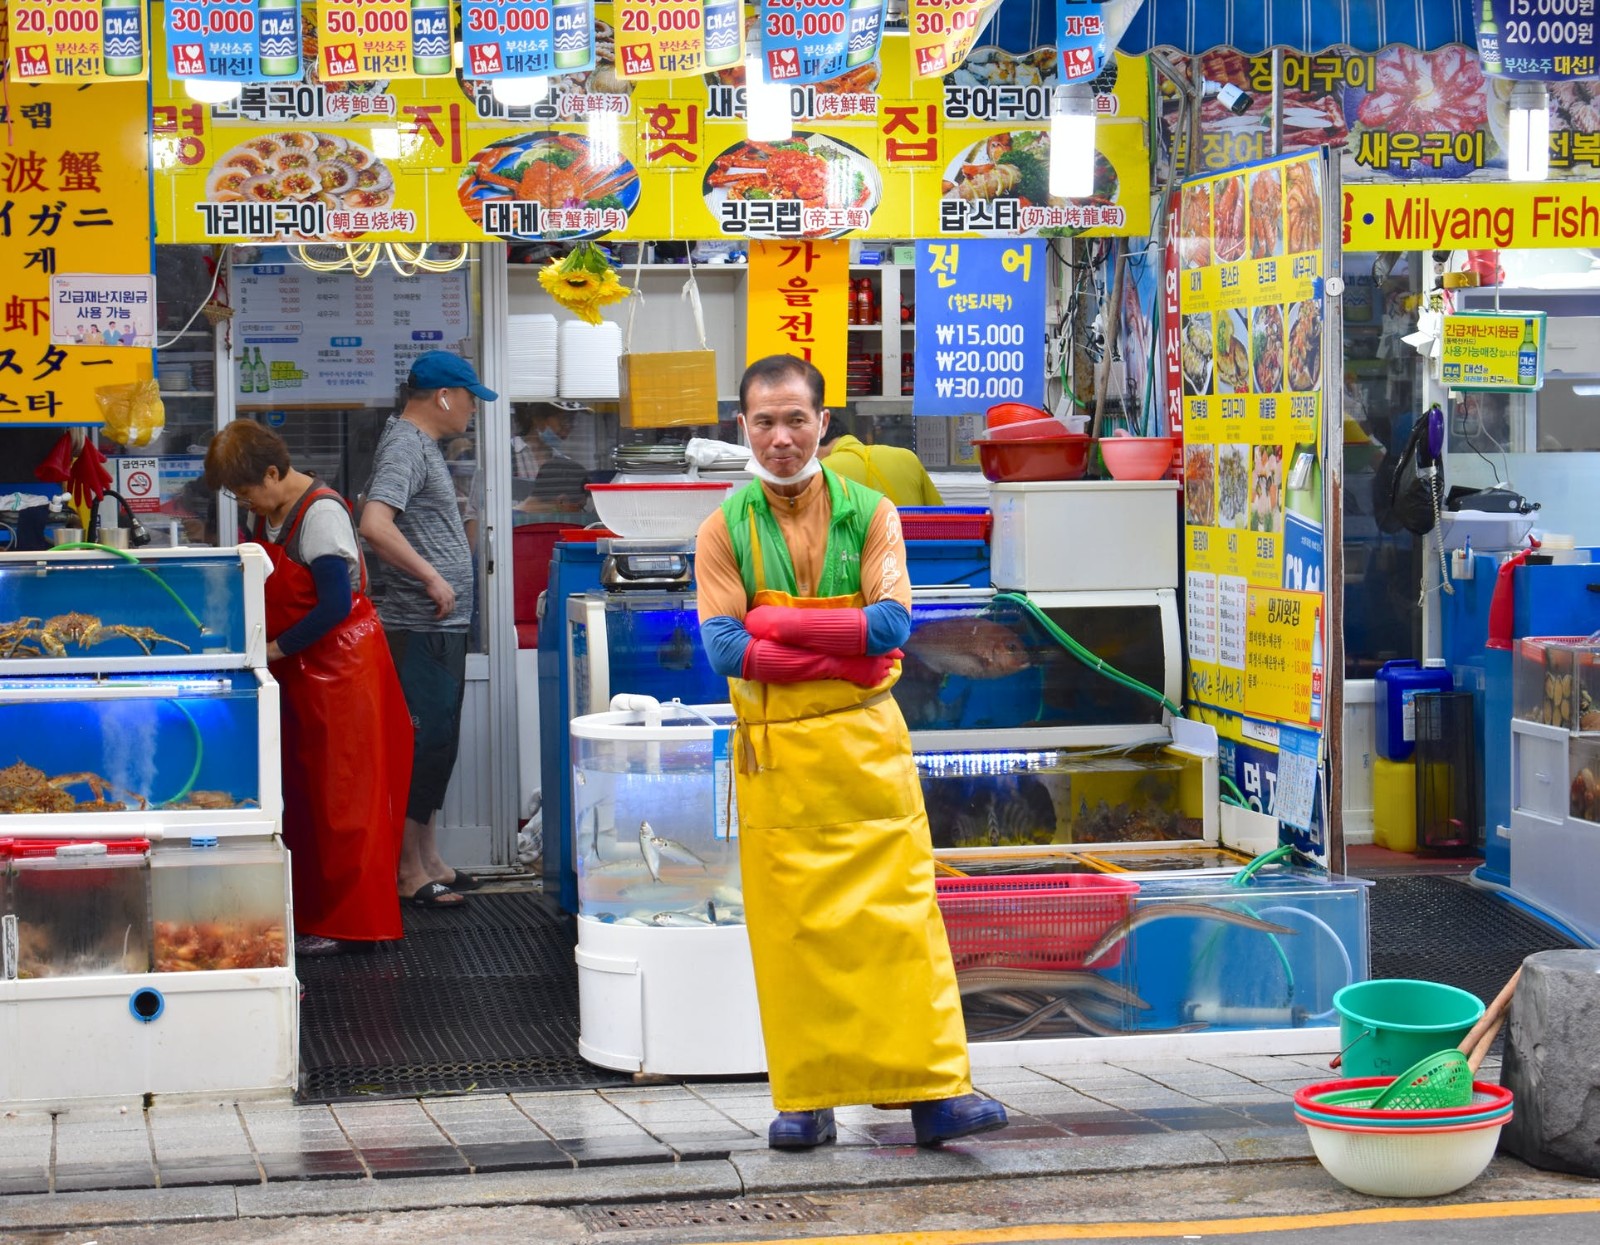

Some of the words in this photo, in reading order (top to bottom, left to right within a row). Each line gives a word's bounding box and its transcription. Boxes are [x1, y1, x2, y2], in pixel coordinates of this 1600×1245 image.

[15, 9, 99, 35] 20,000
[105, 18, 139, 34] 대선
[172, 9, 254, 36] 30,000
[262, 18, 294, 34] 대선
[327, 10, 408, 36] 50,000
[414, 18, 447, 34] 대선
[469, 9, 549, 34] 30,000
[555, 14, 587, 31] 대선
[622, 10, 701, 34] 20,000
[707, 12, 737, 30] 대선
[767, 12, 845, 39] 30,000
[851, 14, 879, 33] 대선
[1067, 17, 1104, 35] 자연
[1506, 21, 1595, 45] 20,000원
[55, 43, 99, 55] 부산소주
[209, 43, 254, 55] 부산소주
[363, 41, 407, 53] 부산소주
[505, 40, 549, 52] 부산소주
[659, 40, 700, 52] 부산소주
[803, 43, 844, 55] 부산소주
[1481, 39, 1499, 49] 대선
[21, 61, 48, 75] 대선
[55, 58, 99, 75] 대선!
[178, 61, 204, 74] 대선
[209, 58, 253, 75] 대선!
[330, 61, 356, 74] 대선
[363, 55, 407, 73] 대선!
[474, 60, 501, 73] 대선
[506, 54, 549, 72] 대선!
[626, 60, 653, 73] 대선
[659, 53, 702, 72] 대선!
[804, 56, 843, 77] 대선!
[920, 60, 946, 74] 대선
[1069, 62, 1093, 77] 대선
[1504, 58, 1553, 74] 부산소주
[1554, 56, 1595, 75] 대선!
[772, 65, 799, 78] 대선
[1249, 57, 1376, 92] 장어구이
[403, 104, 462, 164] 지
[641, 104, 697, 163] 횟
[883, 105, 938, 161] 집
[1356, 131, 1483, 168] 새우구이
[1, 150, 103, 193] 波蟹
[1385, 197, 1514, 248] Milyang
[1531, 196, 1600, 240] Fish
[1220, 265, 1240, 288] 랍스타
[1257, 261, 1277, 284] 킹크랩
[59, 290, 148, 304] 긴급재난지원금
[76, 306, 102, 319] 사용
[106, 306, 131, 319] 가능
[935, 324, 1025, 346] ₩15,000
[1445, 324, 1519, 338] 긴급재난지원금
[935, 350, 1025, 372] ₩20,000
[1520, 357, 1536, 368] 대선
[935, 377, 1025, 399] ₩30,000
[122, 460, 156, 469] 금연구역
[1268, 598, 1301, 627] 명지횟집
